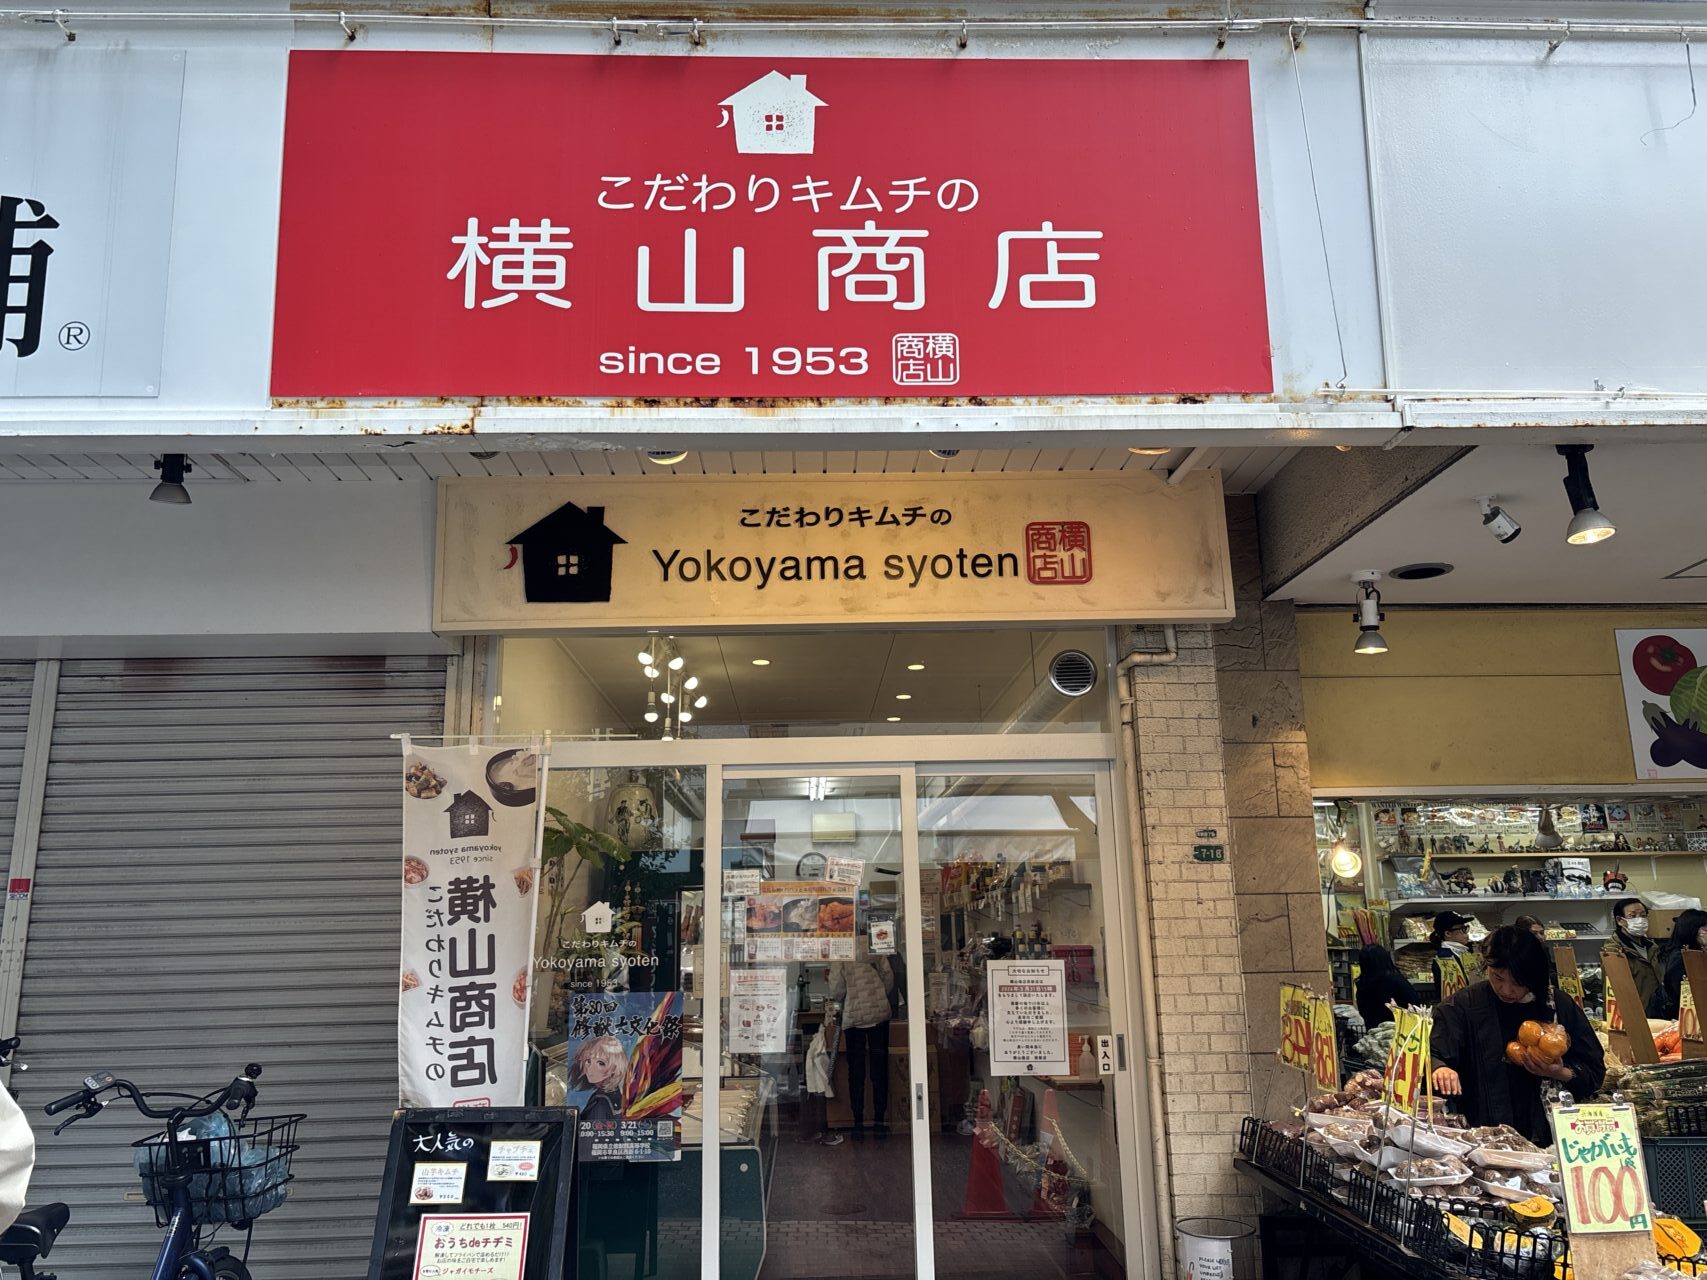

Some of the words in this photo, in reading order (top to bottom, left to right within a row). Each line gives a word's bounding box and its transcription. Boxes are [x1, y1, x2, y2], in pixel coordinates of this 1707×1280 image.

[597, 173, 979, 213] こだわりキムチの
[447, 217, 1103, 313] 横山商店
[599, 345, 721, 376] since
[745, 346, 869, 376] 1953
[739, 506, 952, 528] こだわりキムチの
[652, 548, 866, 589] Yokoyama
[883, 550, 1019, 588] syoten
[562, 940, 637, 949] こだわりキムチの
[533, 956, 606, 971] Yokoyama
[611, 956, 659, 970] syoten
[570, 980, 593, 988] since
[1101, 1039, 1111, 1071] 出入口
[413, 1131, 475, 1153] 大人気の
[1561, 1132, 1638, 1164] じゃがいも
[434, 1236, 513, 1249] おうちdeチヂミ
[442, 1267, 494, 1275] ジャガイモチーズ
